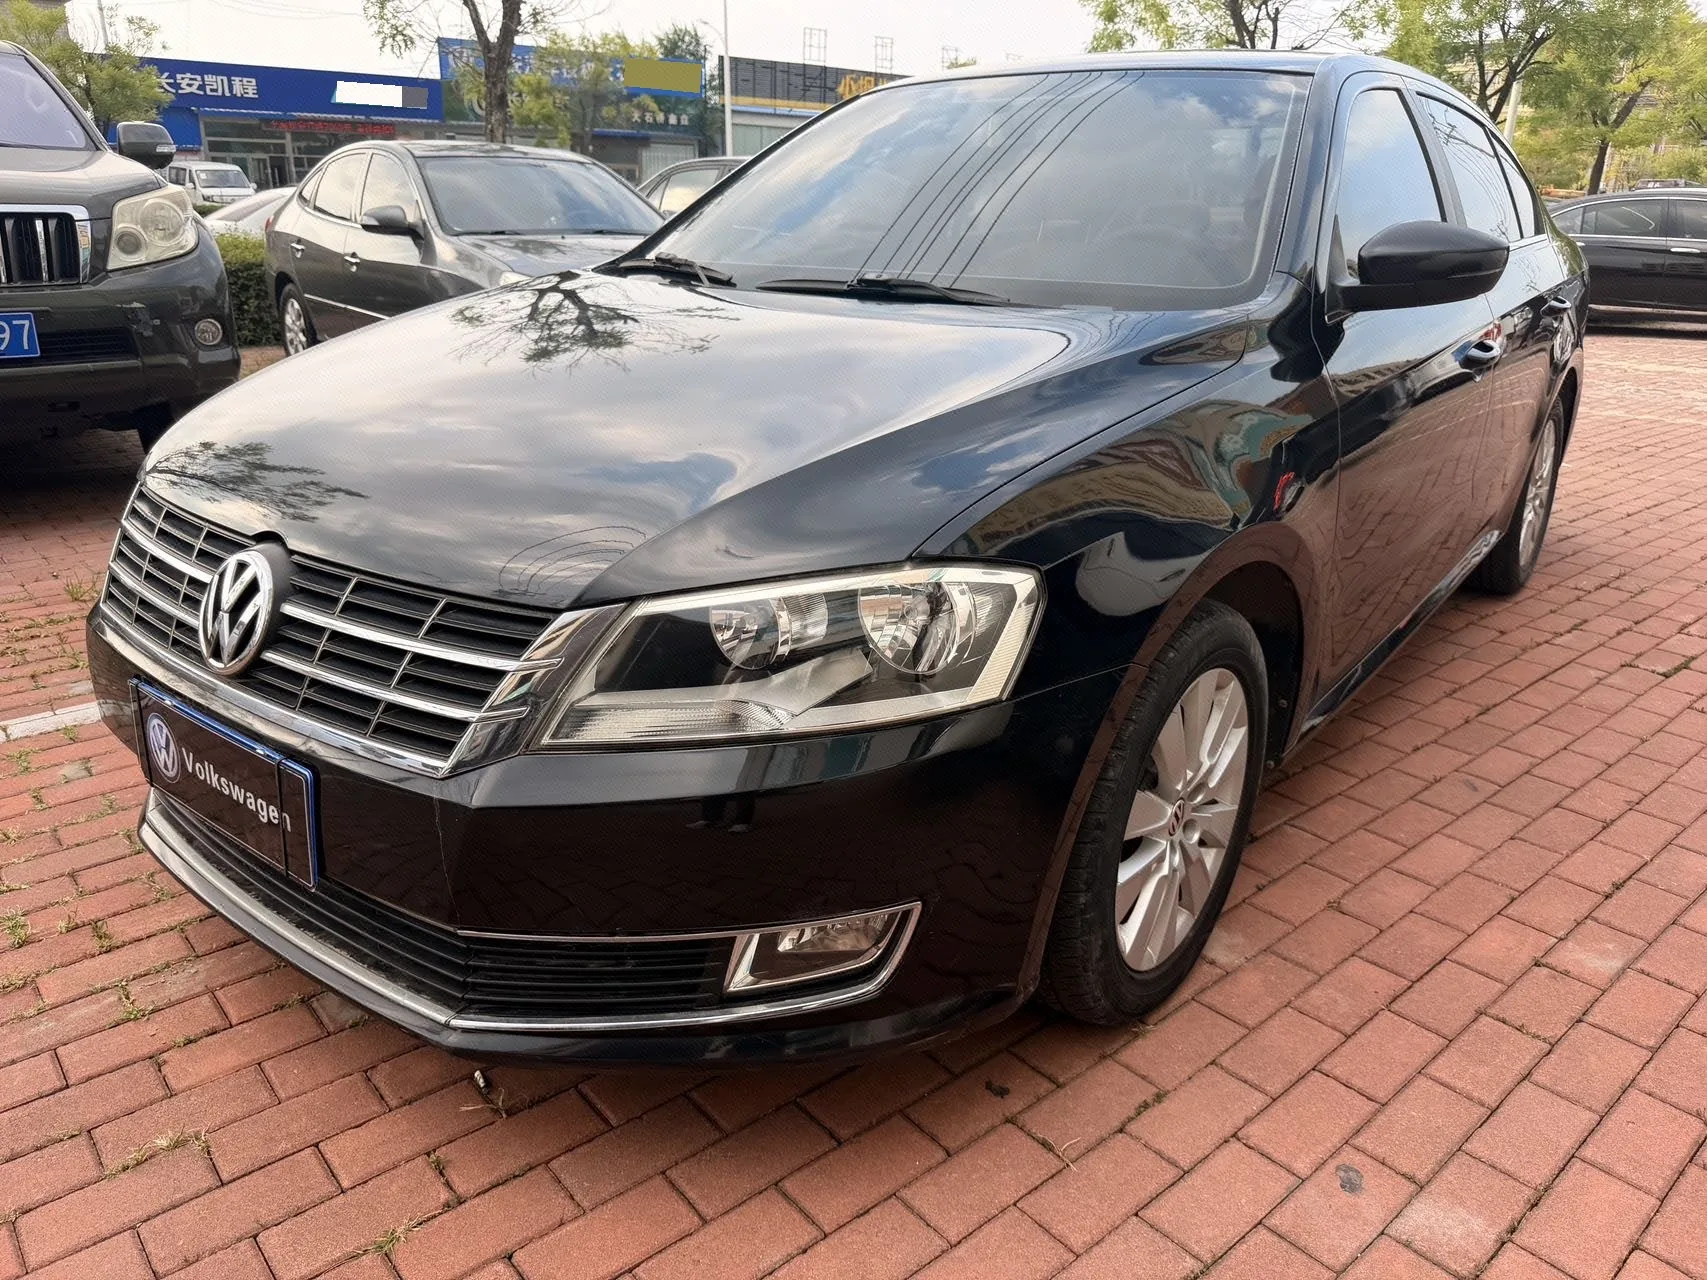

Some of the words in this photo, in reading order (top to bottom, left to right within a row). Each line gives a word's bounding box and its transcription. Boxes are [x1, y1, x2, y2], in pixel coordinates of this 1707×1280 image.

[156, 72, 258, 98] 长安凯程
[182, 748, 291, 832] Volkswagen
